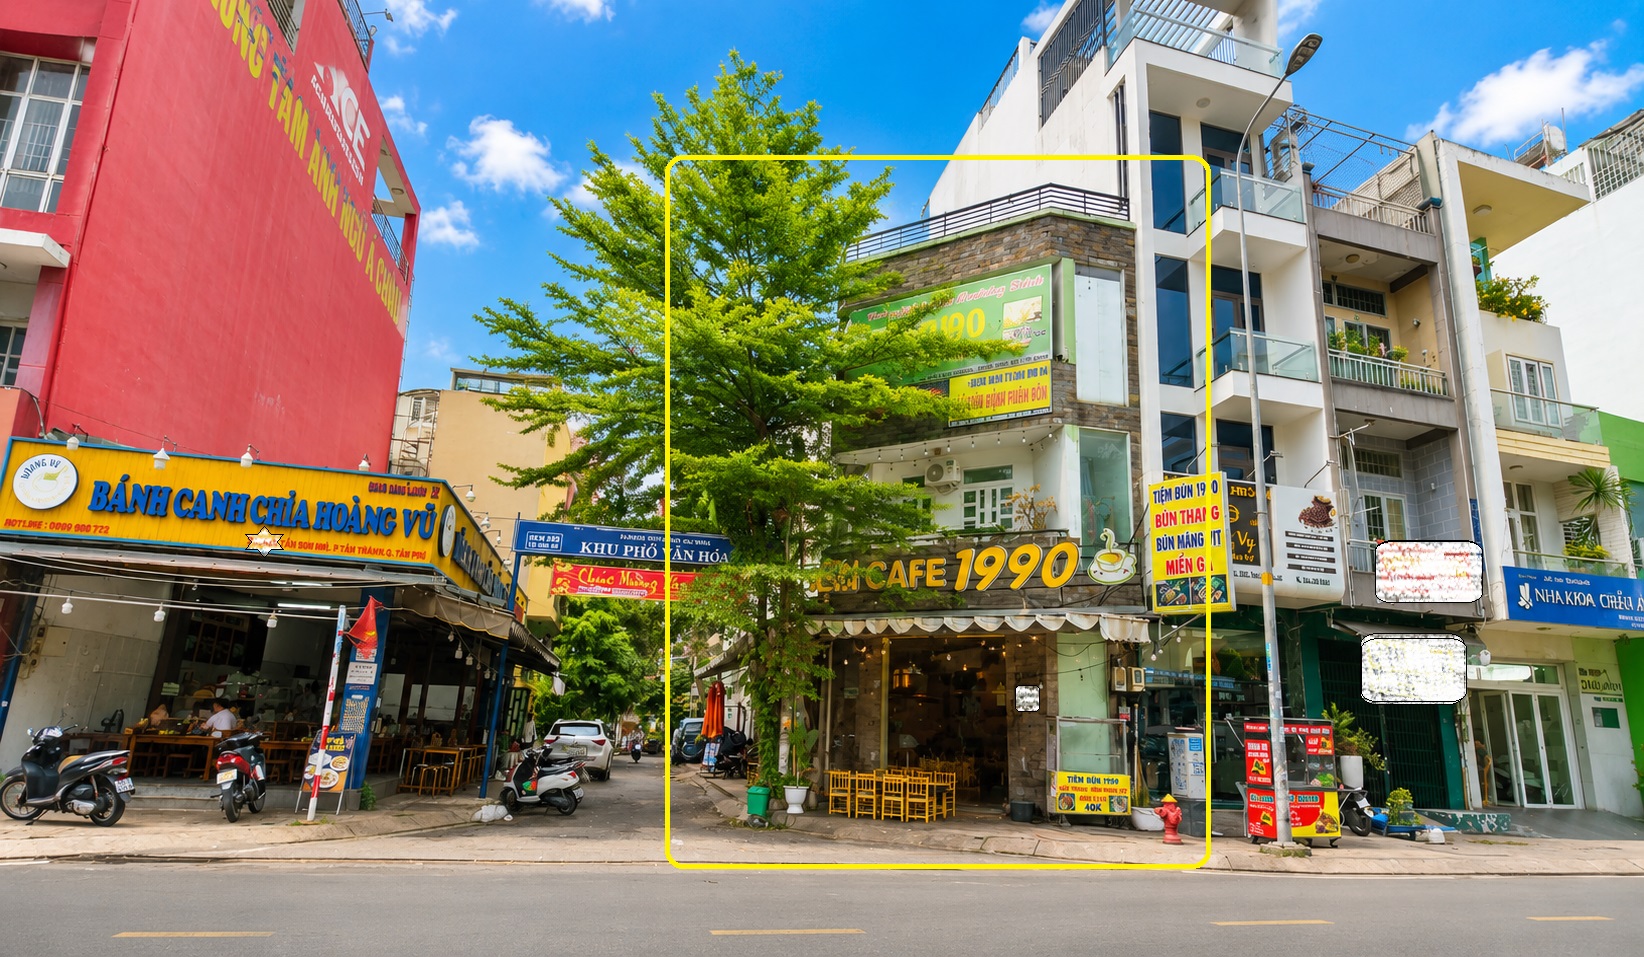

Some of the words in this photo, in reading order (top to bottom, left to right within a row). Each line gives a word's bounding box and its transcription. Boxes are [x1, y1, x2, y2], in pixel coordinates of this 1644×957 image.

[1196, 480, 1219, 497] 190
[87, 474, 172, 517] BÁNH
[172, 487, 251, 524] CANH
[312, 495, 398, 537] HOÀNG
[579, 541, 619, 556] KHU
[698, 548, 729, 563] HÓA
[865, 557, 947, 591] CAFE
[954, 541, 1081, 592] 1990
[1084, 803, 1103, 812] 40K
